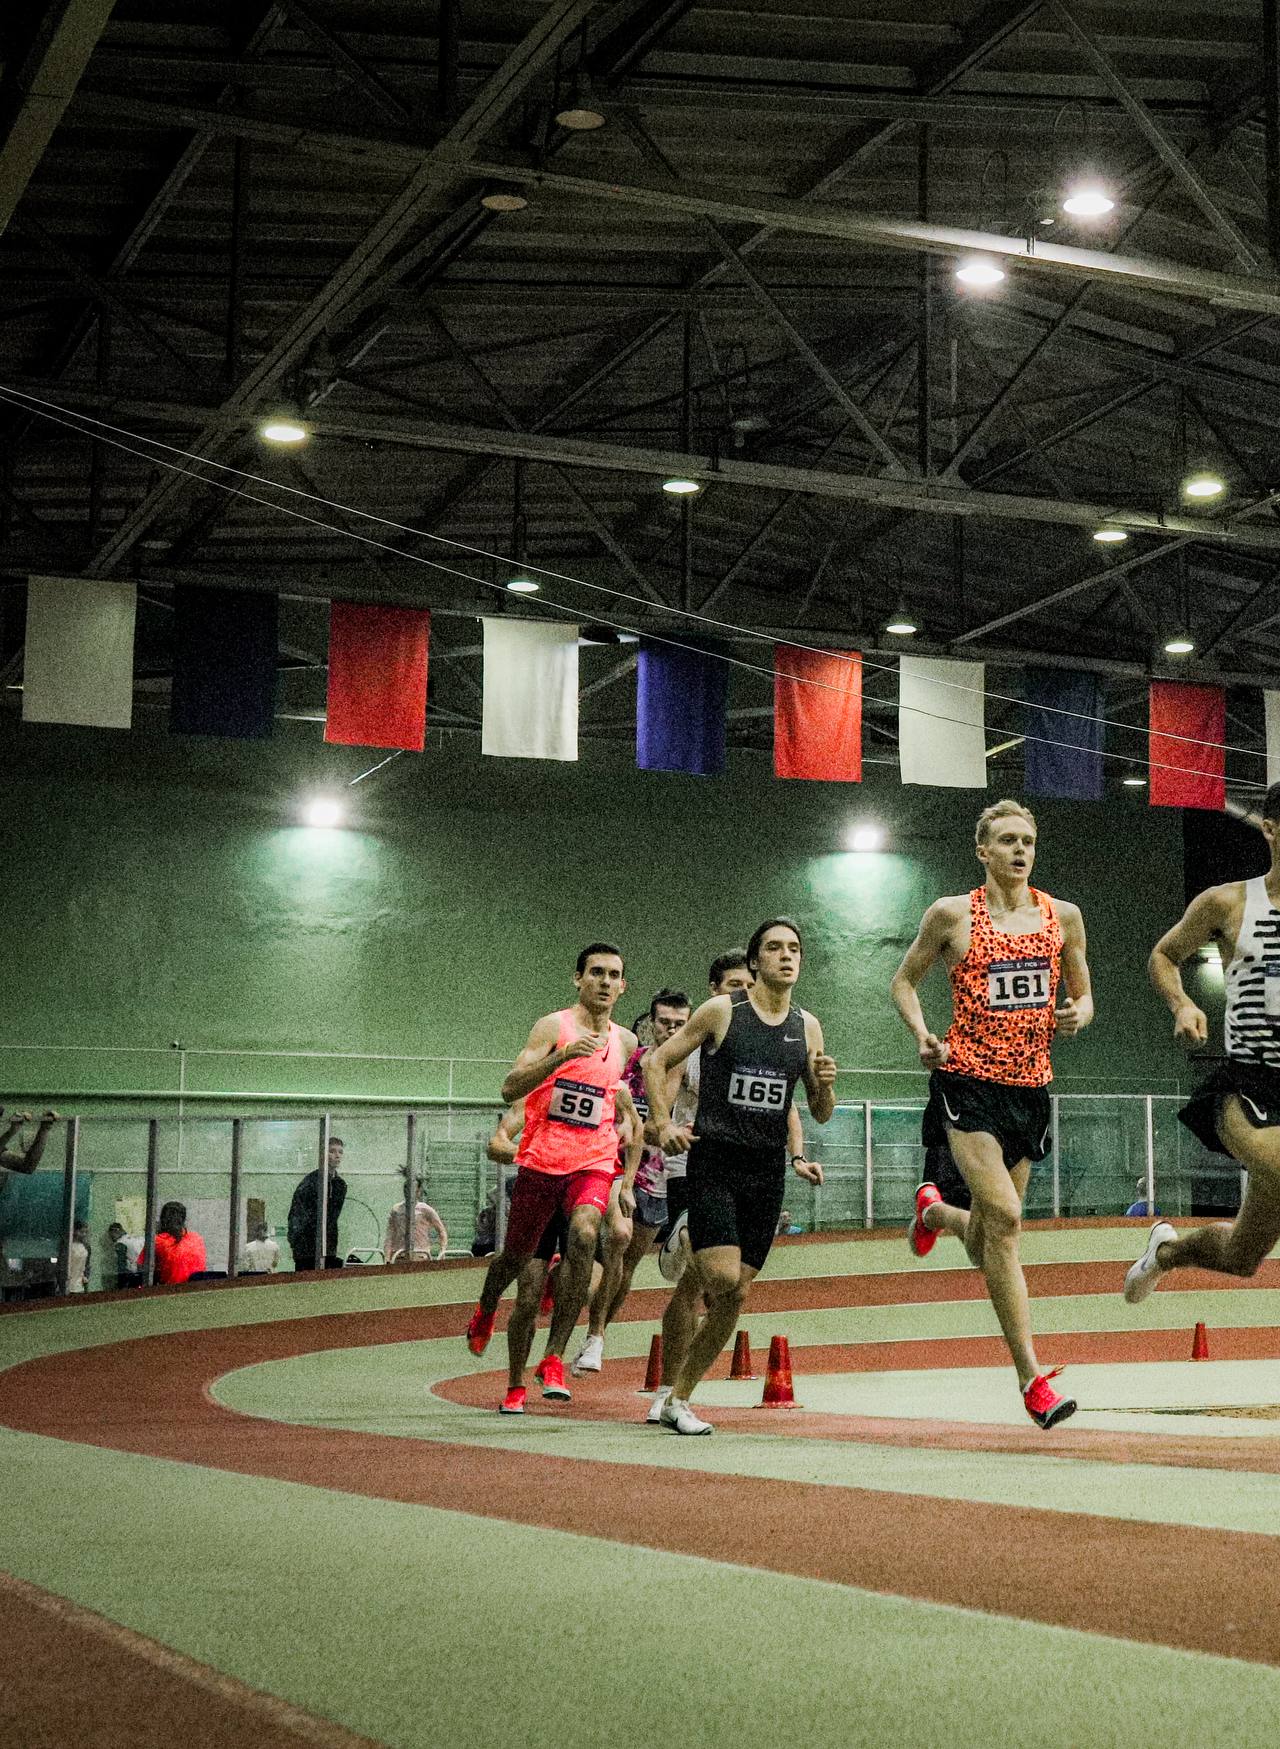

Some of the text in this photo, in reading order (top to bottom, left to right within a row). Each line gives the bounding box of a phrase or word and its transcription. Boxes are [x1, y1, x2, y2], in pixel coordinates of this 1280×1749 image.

[995, 974, 1045, 1000] 161
[732, 1078, 784, 1105] 165
[560, 1092, 594, 1118] 59
